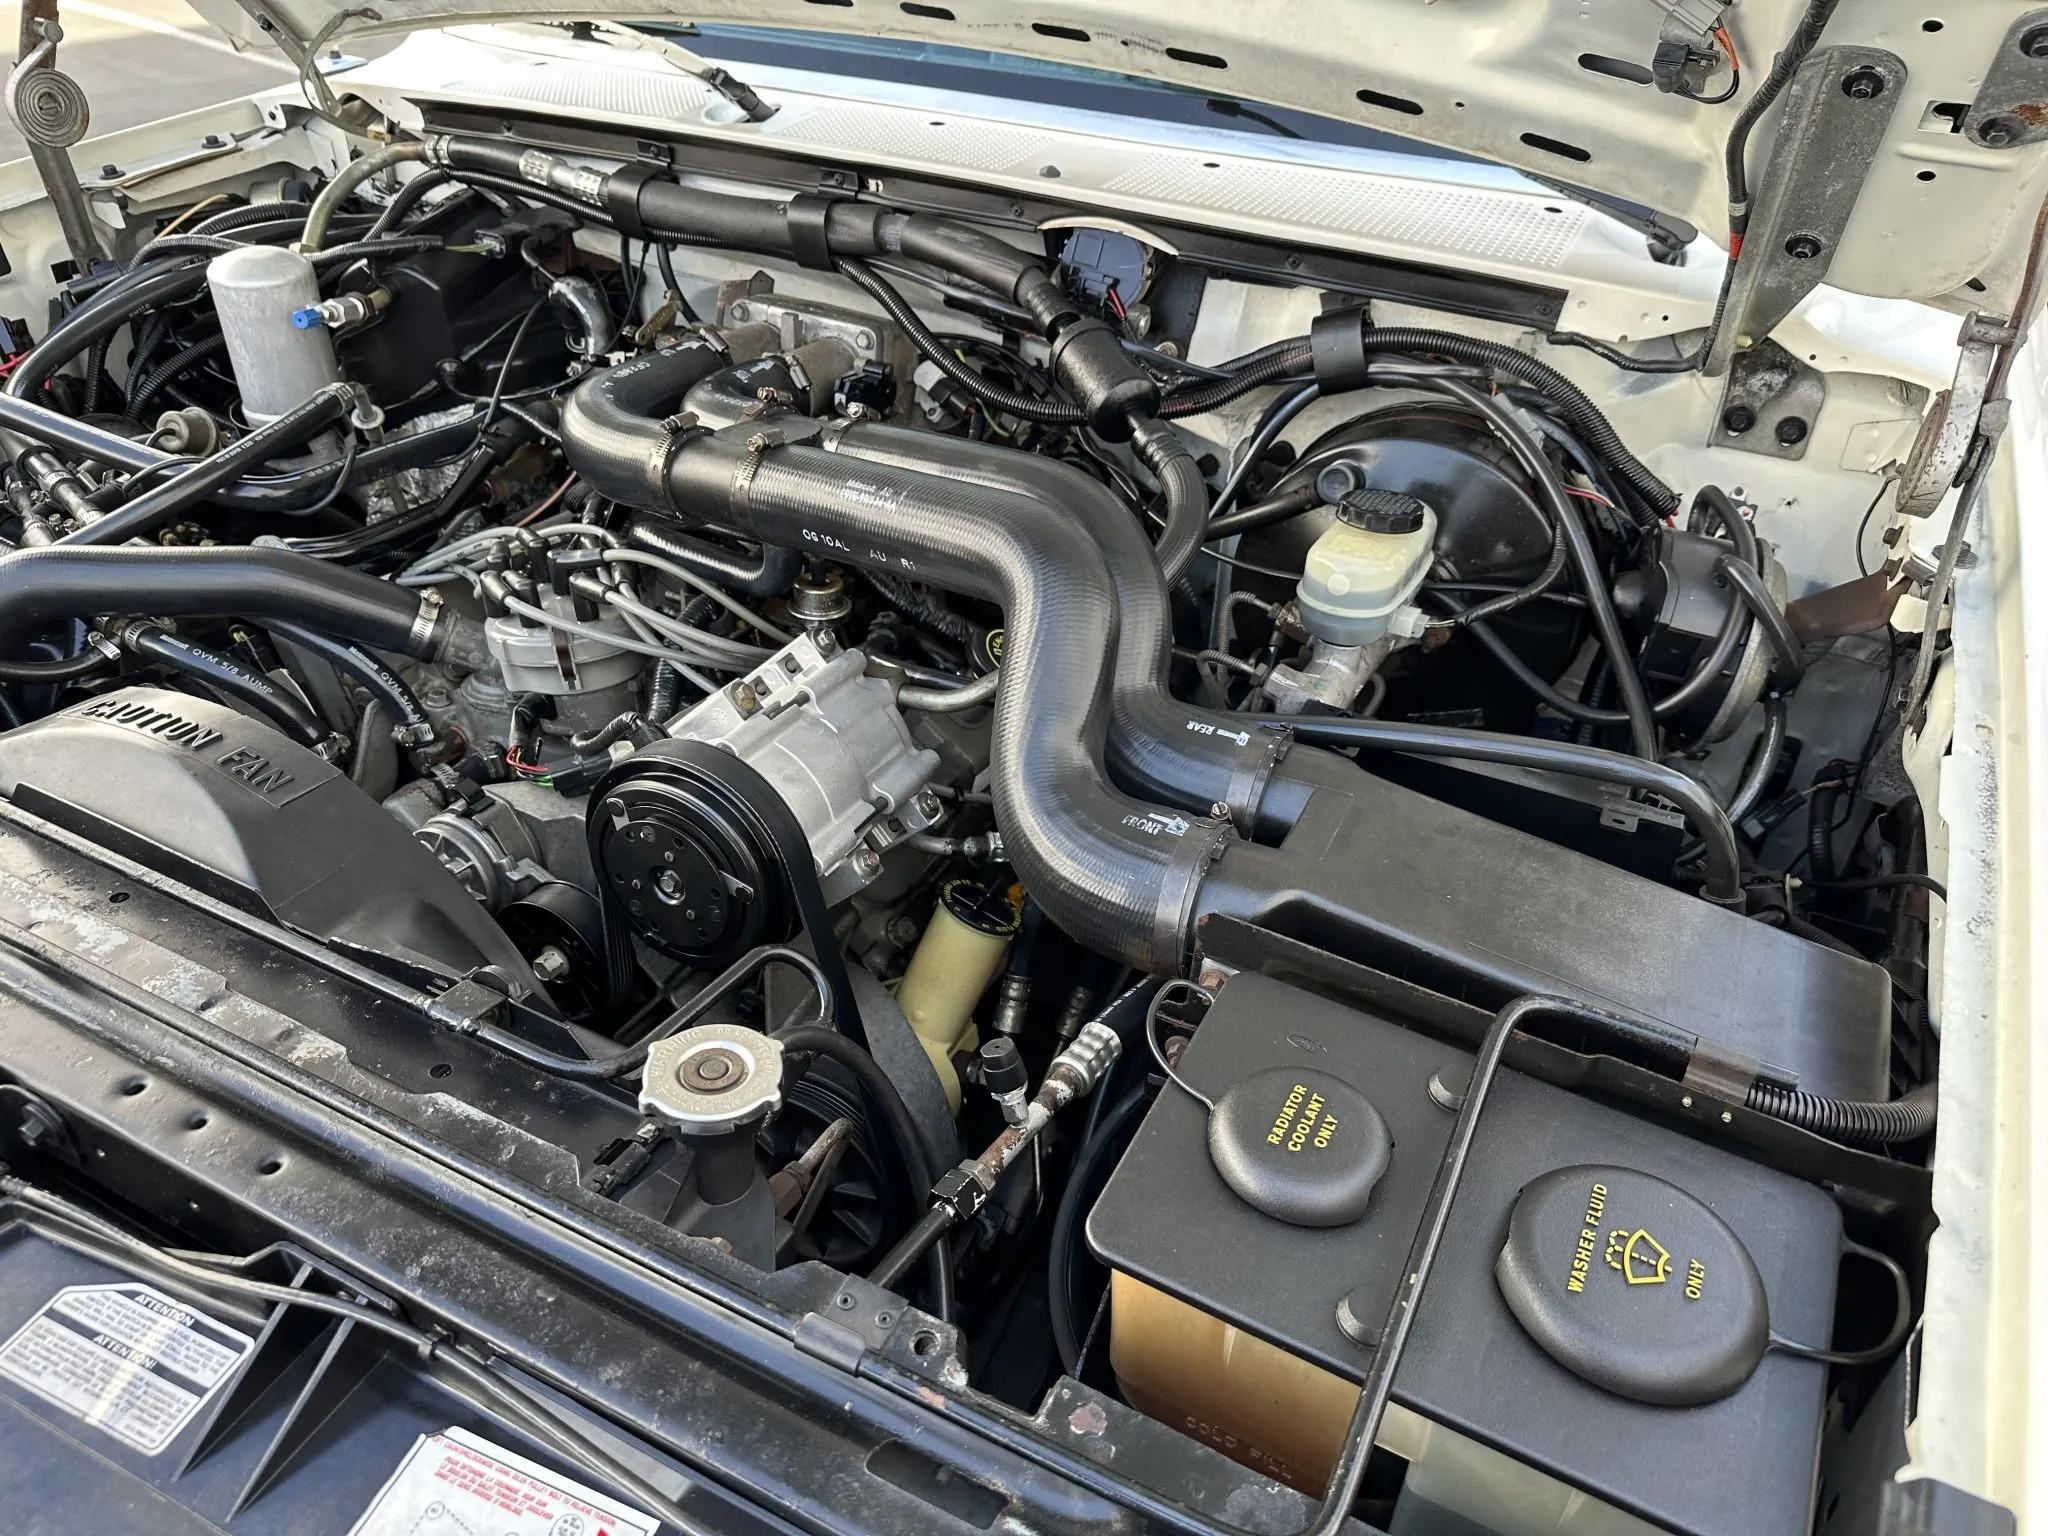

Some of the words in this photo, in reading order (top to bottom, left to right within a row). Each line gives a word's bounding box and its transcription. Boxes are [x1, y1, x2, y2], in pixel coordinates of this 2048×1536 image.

[192, 648, 219, 665] QVM
[221, 661, 238, 675] 5/8
[381, 672, 403, 695] QVM
[401, 694, 415, 712] 5/8
[82, 700, 224, 750] CAUTION
[216, 746, 296, 793] FAN
[1186, 720, 1216, 736] REAR
[1121, 814, 1163, 836] FRONT
[1266, 1084, 1308, 1145] RADIATOR
[1287, 1092, 1325, 1152] COOLANT
[1313, 1114, 1338, 1149] ONLY
[1567, 1228, 1597, 1293] WASHER
[1585, 1183, 1608, 1227] FLUID
[1685, 1258, 1705, 1300] ONLY
[134, 1293, 195, 1327] ATTENTION
[93, 1334, 157, 1370] ATTENTION!
